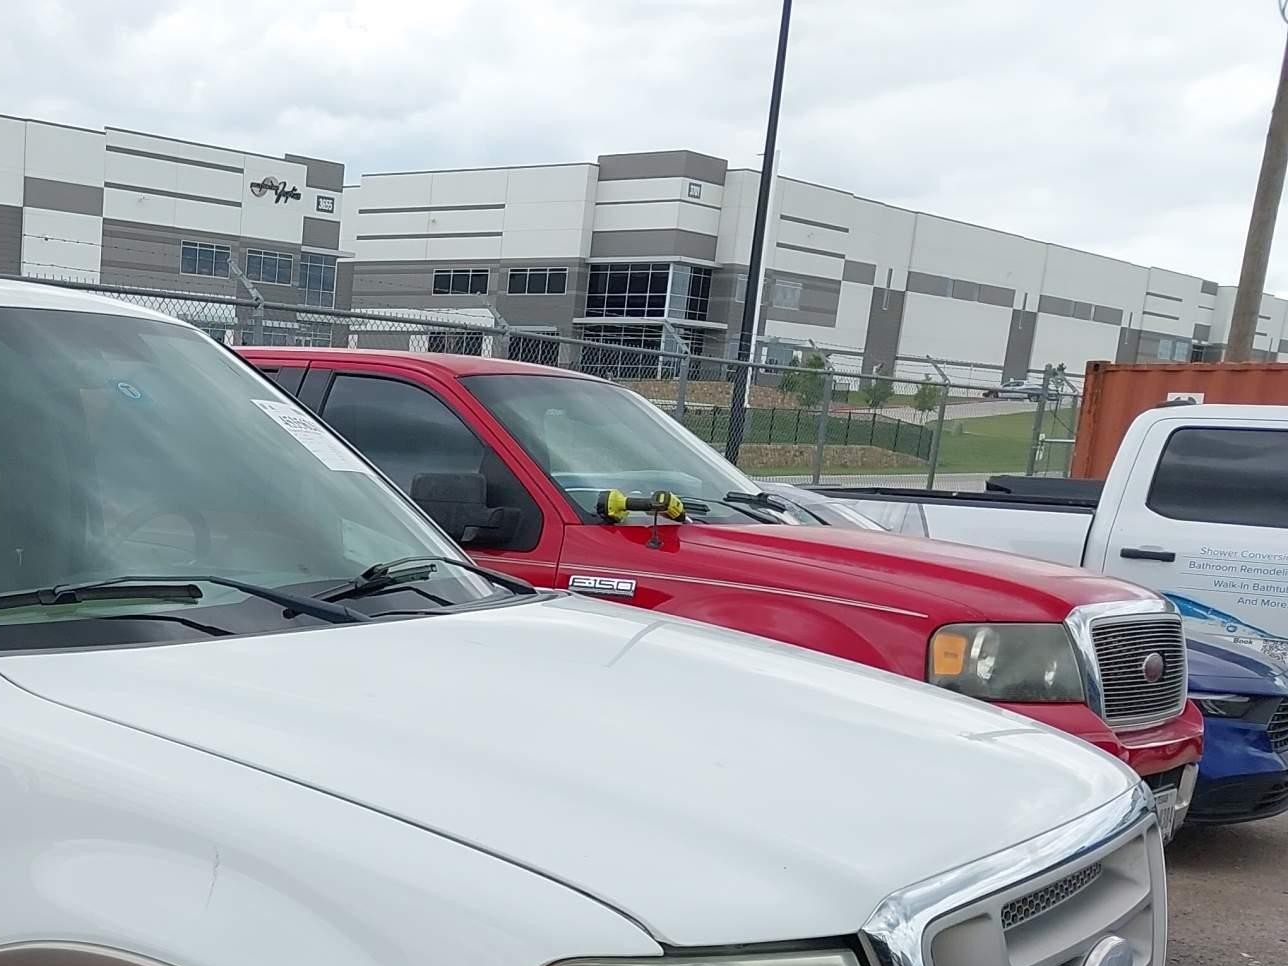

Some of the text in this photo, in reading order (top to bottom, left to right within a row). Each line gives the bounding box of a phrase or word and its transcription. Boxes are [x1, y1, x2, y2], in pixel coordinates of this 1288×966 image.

[1200, 547, 1237, 558] Shower
[1189, 561, 1237, 573] Bathroom
[1214, 580, 1249, 591] Walk-In
[1237, 597, 1257, 606] And
